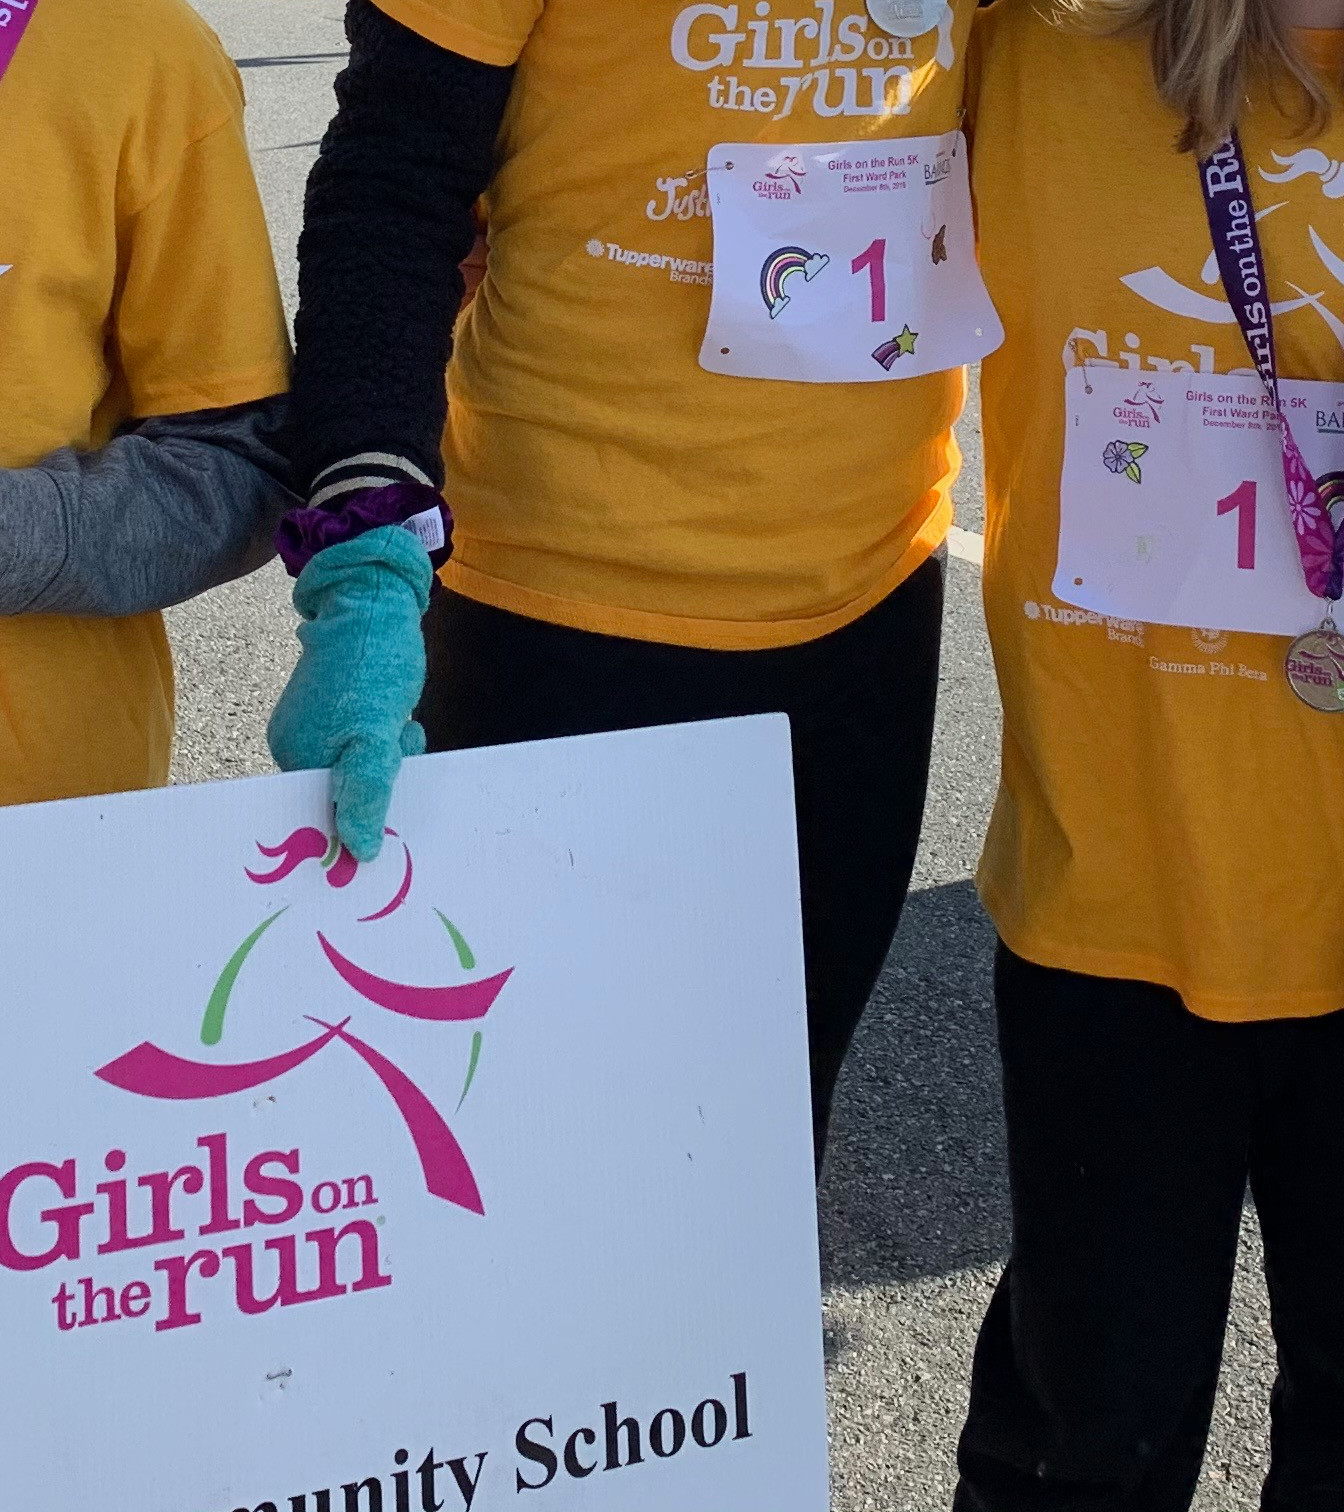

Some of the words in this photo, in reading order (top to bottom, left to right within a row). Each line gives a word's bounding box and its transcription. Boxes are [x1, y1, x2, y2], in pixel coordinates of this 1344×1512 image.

[868, 35, 915, 60] on
[707, 75, 777, 114] the
[773, 66, 916, 121] run
[827, 159, 852, 171] Girls
[855, 161, 868, 170] on
[870, 158, 886, 168] the
[887, 156, 906, 167] Run
[906, 154, 920, 165] 5K
[842, 173, 864, 184] First
[866, 172, 888, 182] Ward
[889, 170, 907, 181] Park
[1206, 132, 1245, 199] Ru
[752, 180, 784, 193] Girls
[1226, 199, 1253, 253] the
[606, 242, 714, 273] Tupperware
[850, 238, 887, 323] 1
[1234, 252, 1262, 298] on
[1112, 406, 1143, 419] Girls
[1185, 390, 1214, 403] Girls
[1217, 394, 1233, 405] on
[1237, 394, 1257, 406] the
[1260, 395, 1287, 408] Rn
[1290, 397, 1307, 409] 5K
[1202, 406, 1228, 419] First
[1230, 408, 1259, 420] Ward
[1128, 417, 1151, 429] run
[1215, 480, 1258, 571] 1
[1149, 655, 1205, 675] Gamma
[1209, 661, 1234, 676] Phi
[310, 1173, 379, 1218] on
[51, 1277, 151, 1332] the
[155, 1216, 393, 1333] run
[514, 1371, 753, 1495] School
